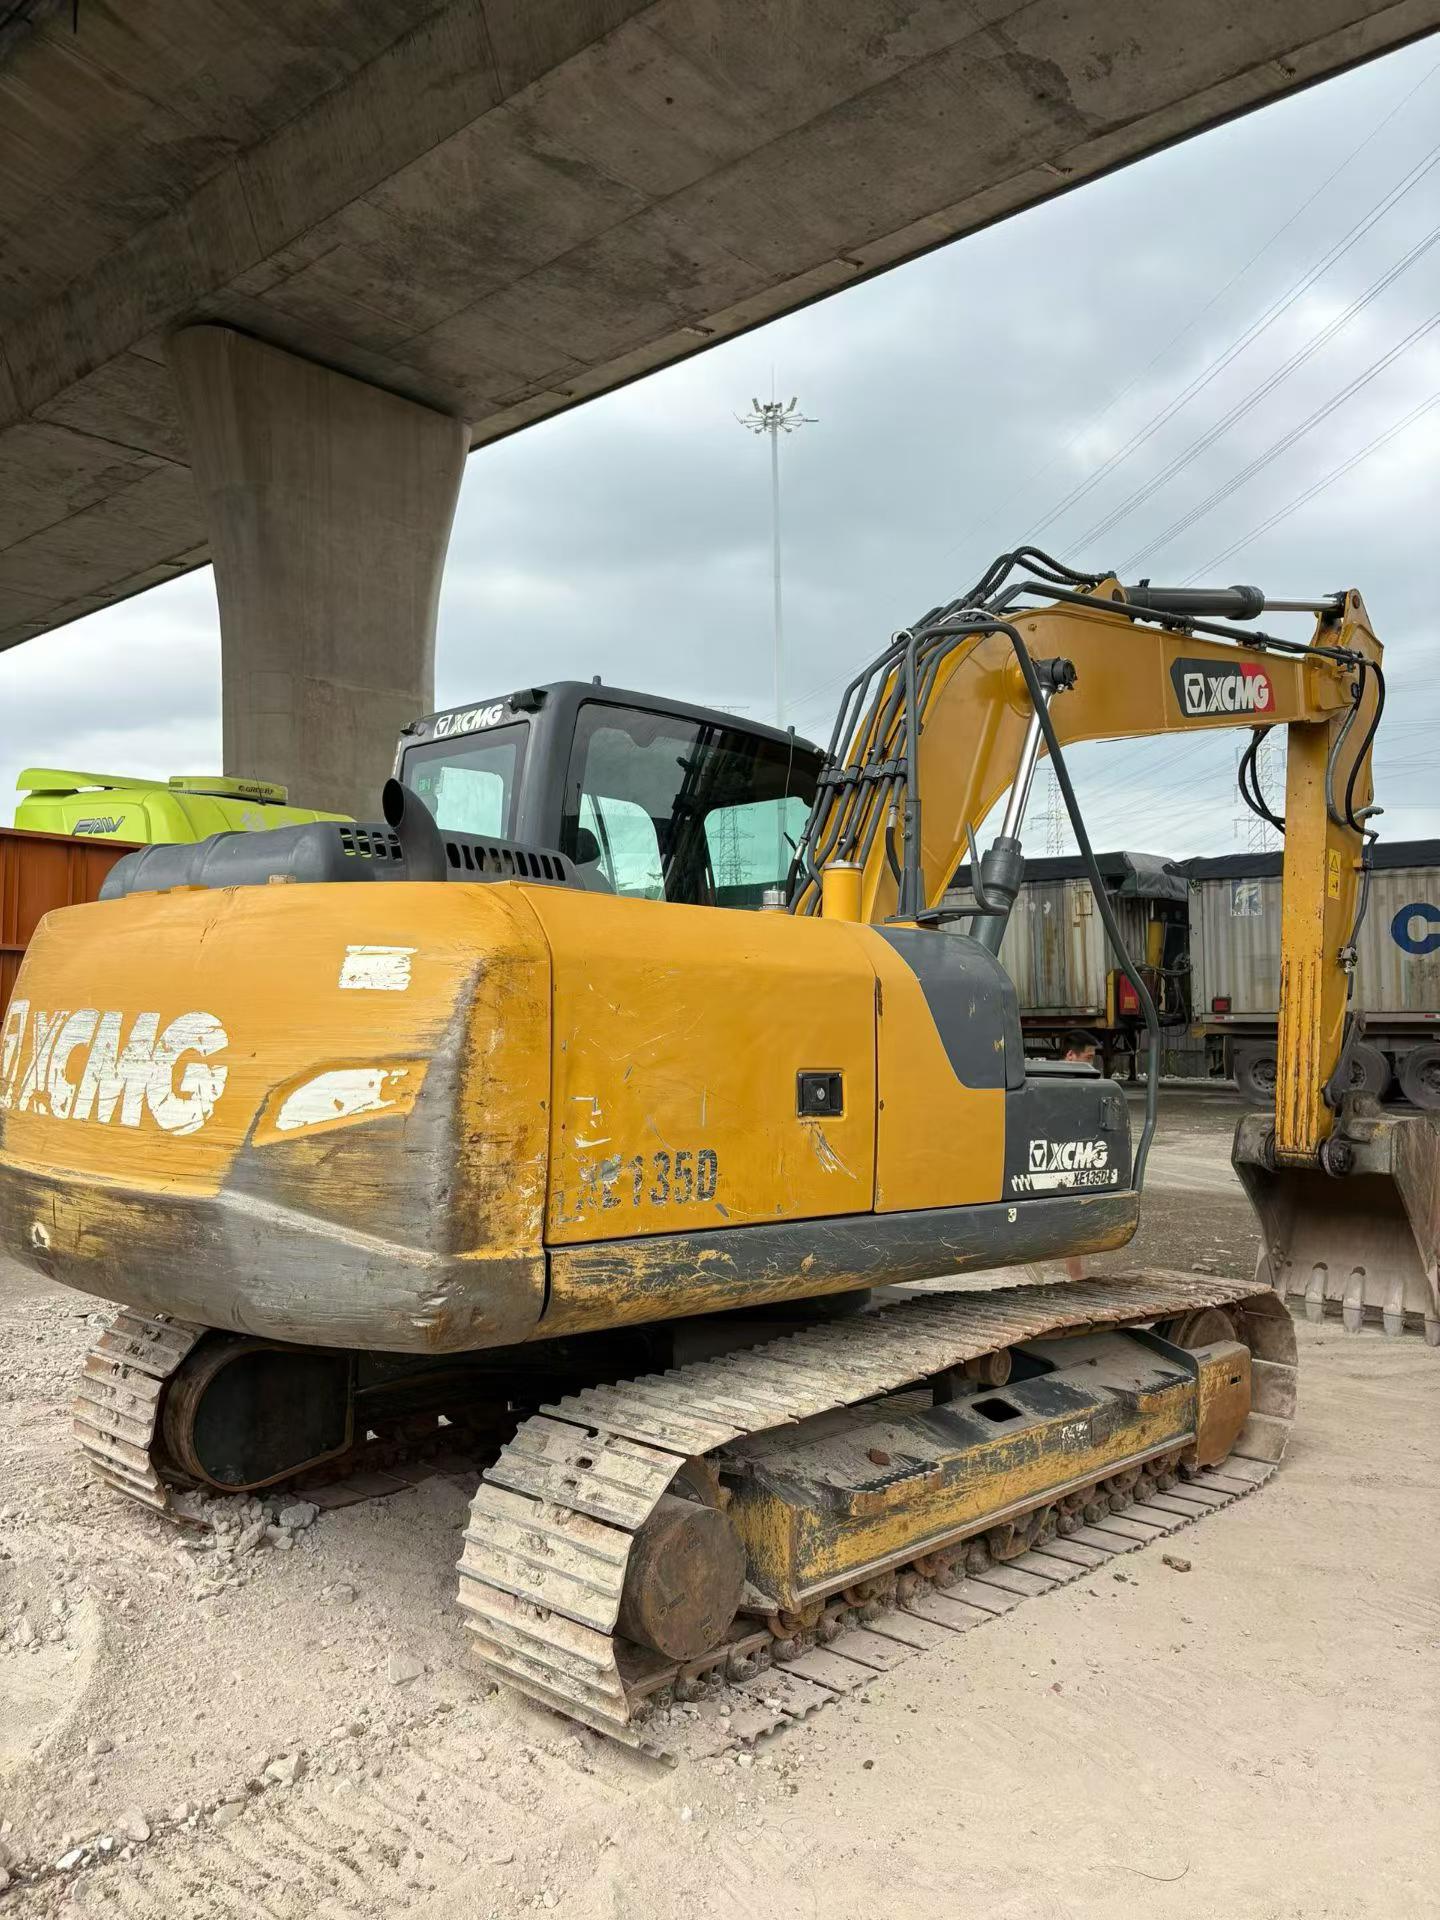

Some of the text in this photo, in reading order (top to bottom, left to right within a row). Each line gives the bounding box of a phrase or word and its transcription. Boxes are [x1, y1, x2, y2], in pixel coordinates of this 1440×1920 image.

[1206, 674, 1270, 712] XCMG
[449, 704, 504, 735] XCMG
[72, 815, 126, 836] FAW
[19, 1007, 229, 1136] XCMG
[1046, 1140, 1109, 1171] XCMG
